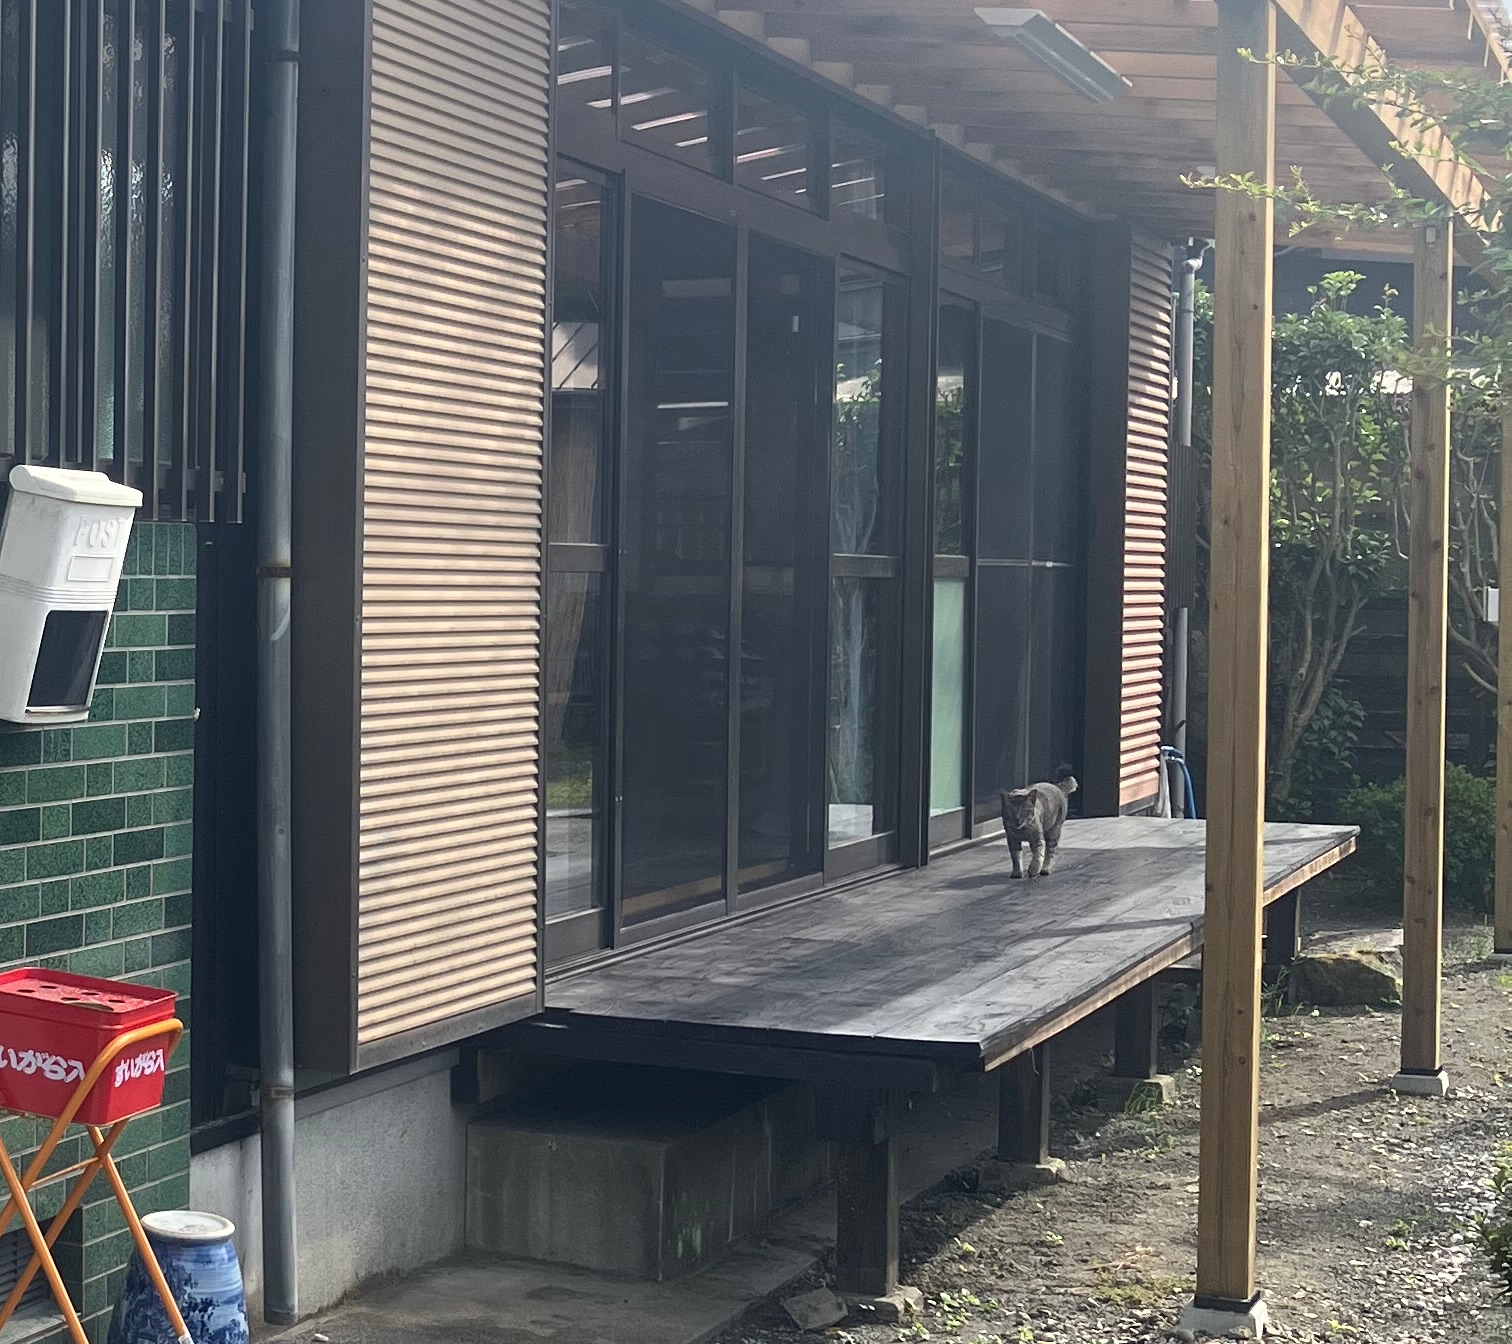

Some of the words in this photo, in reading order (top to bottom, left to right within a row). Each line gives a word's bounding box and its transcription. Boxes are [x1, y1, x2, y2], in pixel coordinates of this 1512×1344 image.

[72, 517, 126, 548] POST
[114, 1048, 165, 1088] すいがら入
